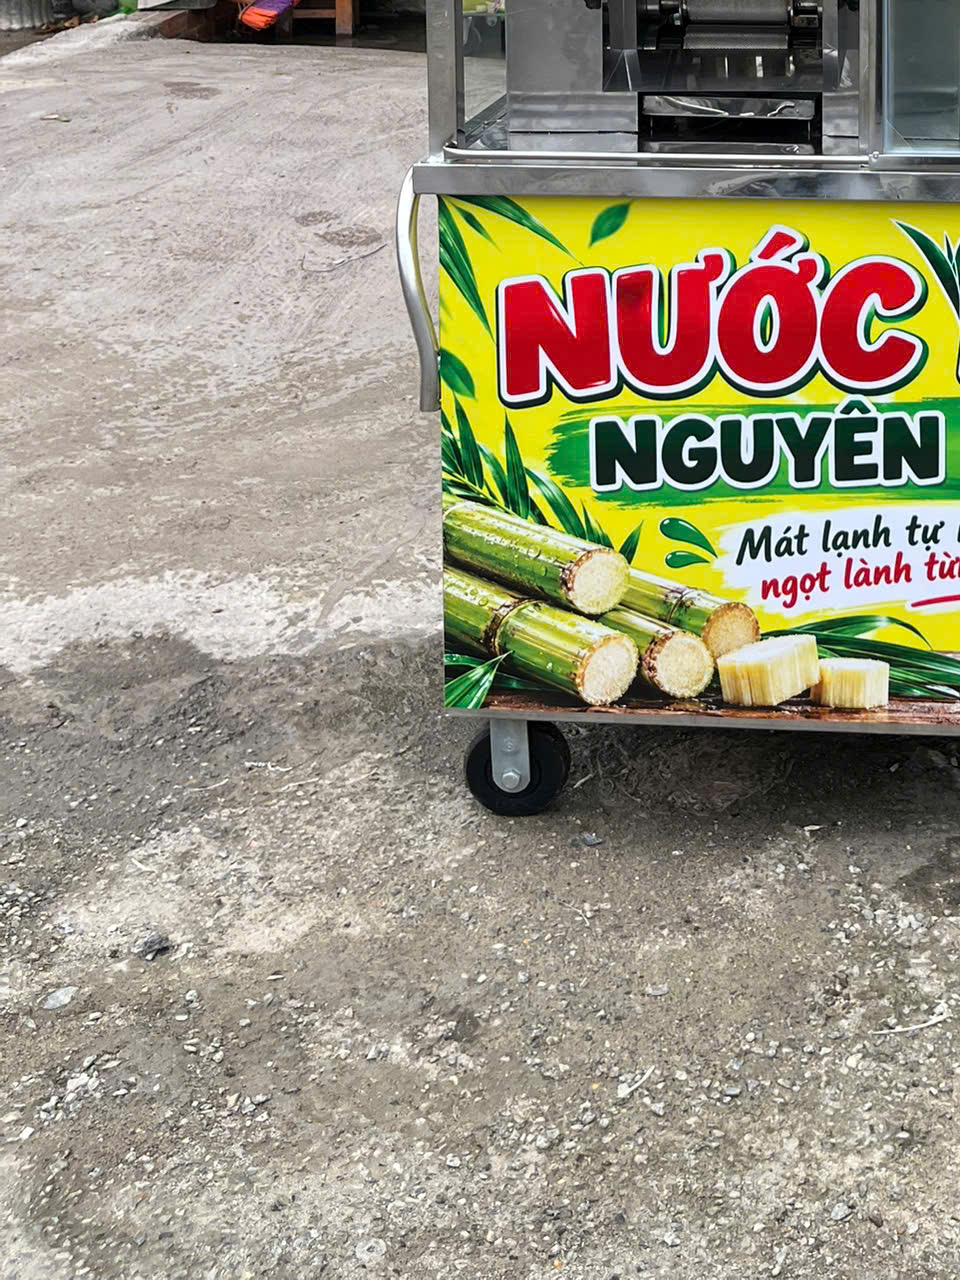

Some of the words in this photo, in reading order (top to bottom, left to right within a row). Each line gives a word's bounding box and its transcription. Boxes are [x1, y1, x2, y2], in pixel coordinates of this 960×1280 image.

[499, 228, 926, 402] NƯỚC
[591, 400, 945, 492] NGUYÊN
[735, 525, 808, 566] Mát
[821, 515, 892, 559] lạnh
[906, 515, 945, 552] tự
[761, 561, 831, 609] ngọt
[843, 550, 913, 591] lành
